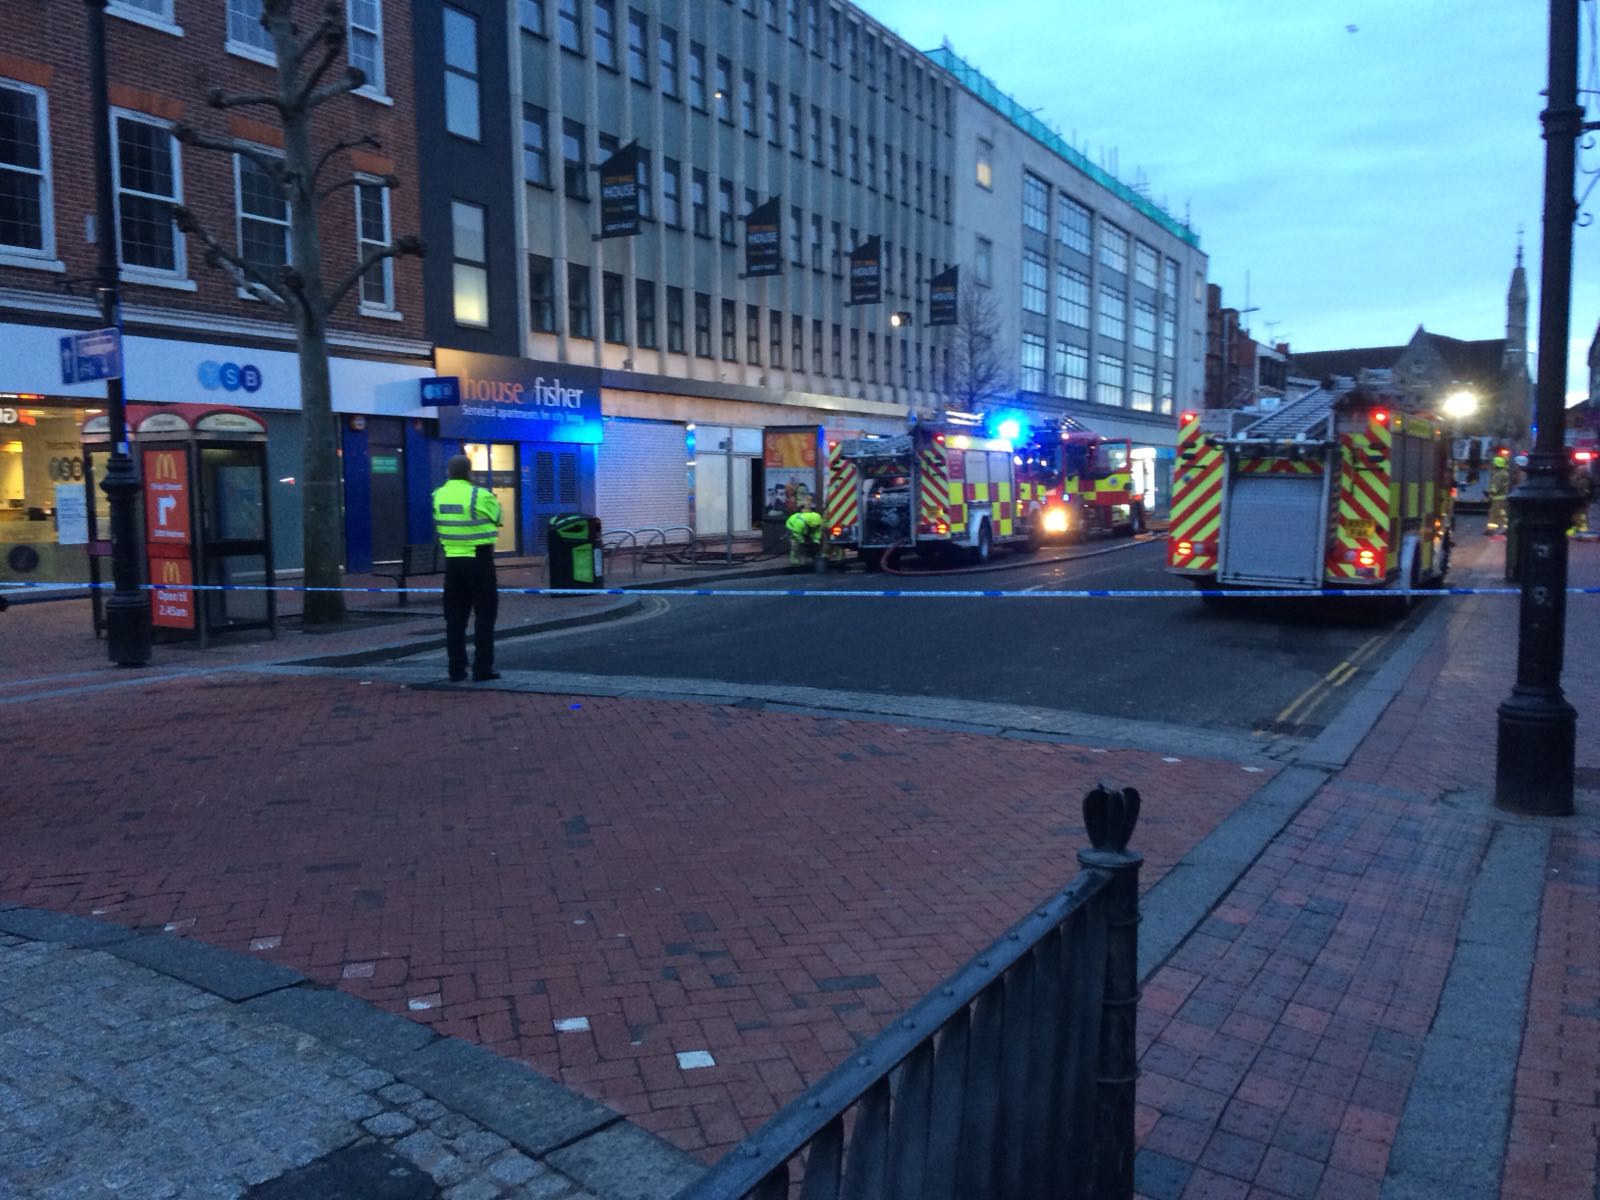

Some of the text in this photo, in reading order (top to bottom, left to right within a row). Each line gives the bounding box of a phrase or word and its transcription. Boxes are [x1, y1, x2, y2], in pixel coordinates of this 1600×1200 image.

[603, 183, 636, 198] HOUSE
[748, 231, 777, 244] HOUSE
[462, 370, 584, 409] house fisher
[158, 590, 177, 603] Open
